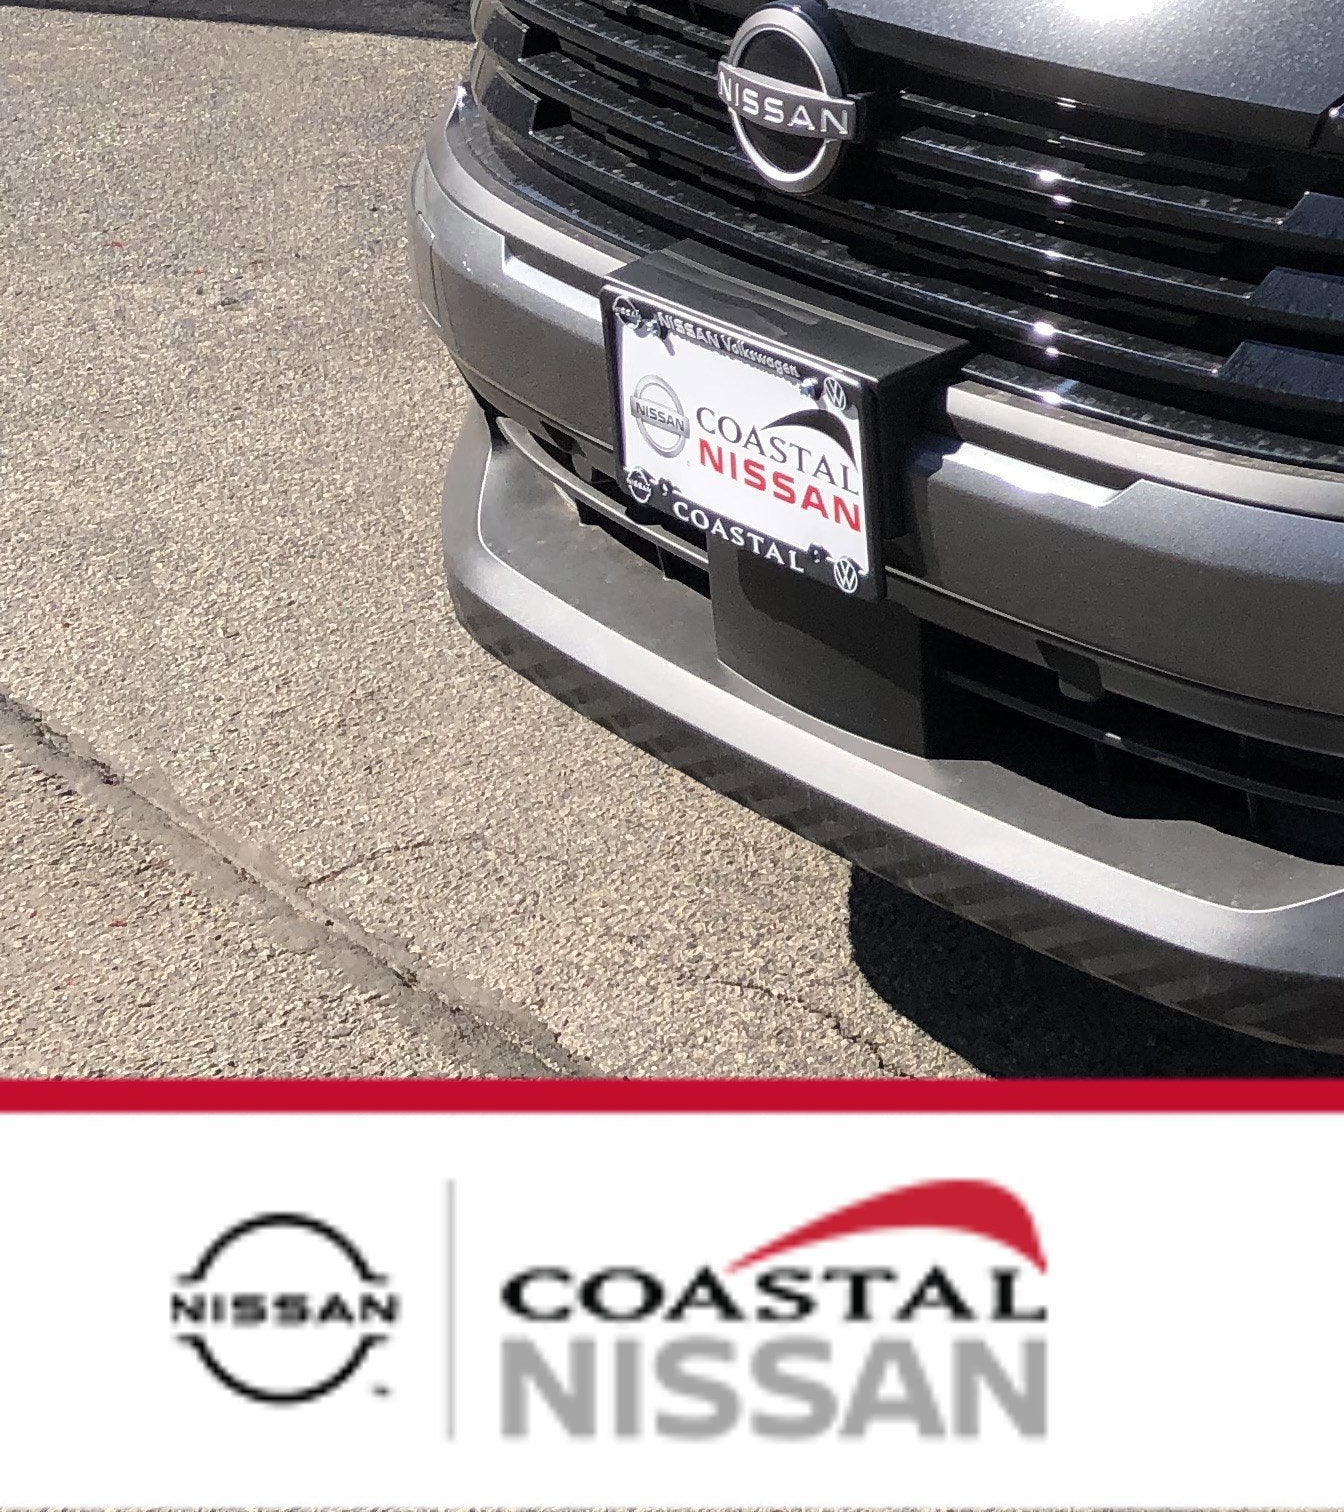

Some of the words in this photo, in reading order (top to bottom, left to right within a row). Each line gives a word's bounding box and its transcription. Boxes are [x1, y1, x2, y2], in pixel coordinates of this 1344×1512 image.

[718, 71, 849, 135] NISSAN
[657, 311, 721, 349] NISSAN
[720, 334, 801, 378] Volkswagen
[636, 401, 685, 431] NISSAN
[696, 406, 860, 496] COASTAL
[699, 438, 861, 533] NISSAN
[672, 501, 804, 573] COASTAL
